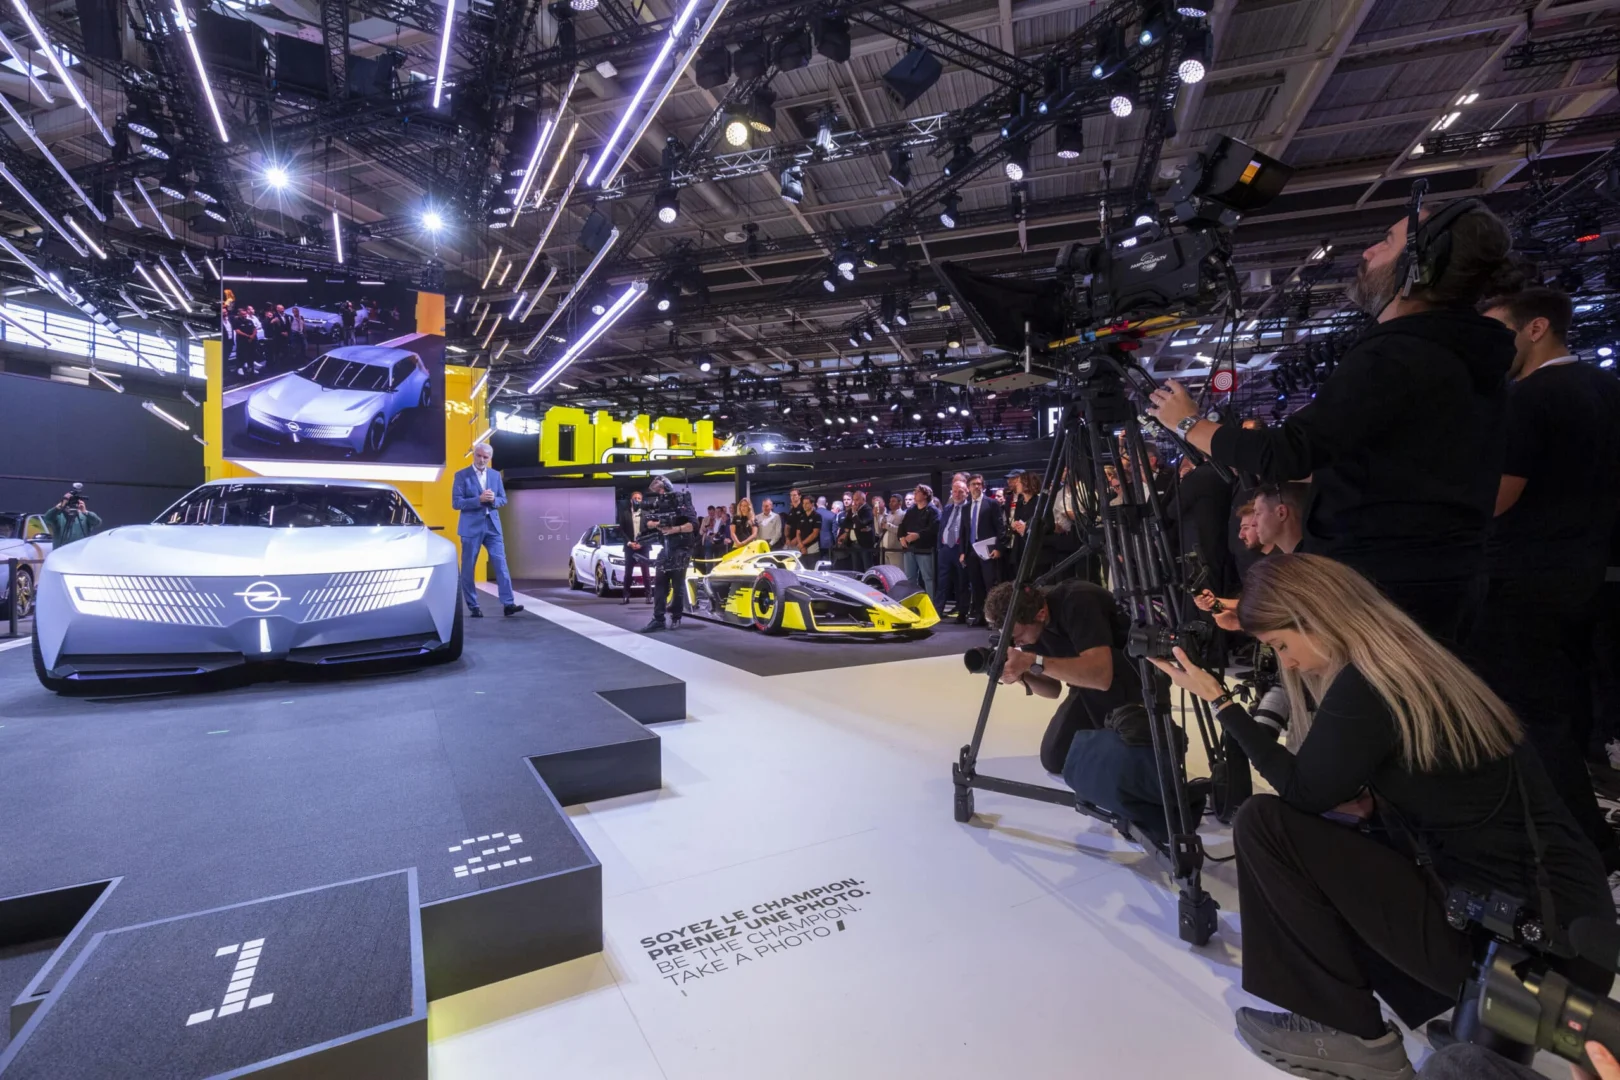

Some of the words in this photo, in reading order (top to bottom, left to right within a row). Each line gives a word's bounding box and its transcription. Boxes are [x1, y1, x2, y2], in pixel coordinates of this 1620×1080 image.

[448, 832, 533, 878] 2
[639, 918, 716, 949] SOYEZ
[720, 910, 749, 925] LE
[752, 877, 865, 915] CHAMPION.
[647, 924, 743, 961] PRENEZ
[744, 909, 793, 930] UNE
[793, 888, 871, 915] PHOTO.
[656, 955, 690, 974] BE
[692, 938, 743, 960] THE
[747, 903, 862, 944] CHAMPION.
[186, 938, 274, 1026] 1
[663, 958, 729, 986] TAKE
[736, 953, 753, 965] A
